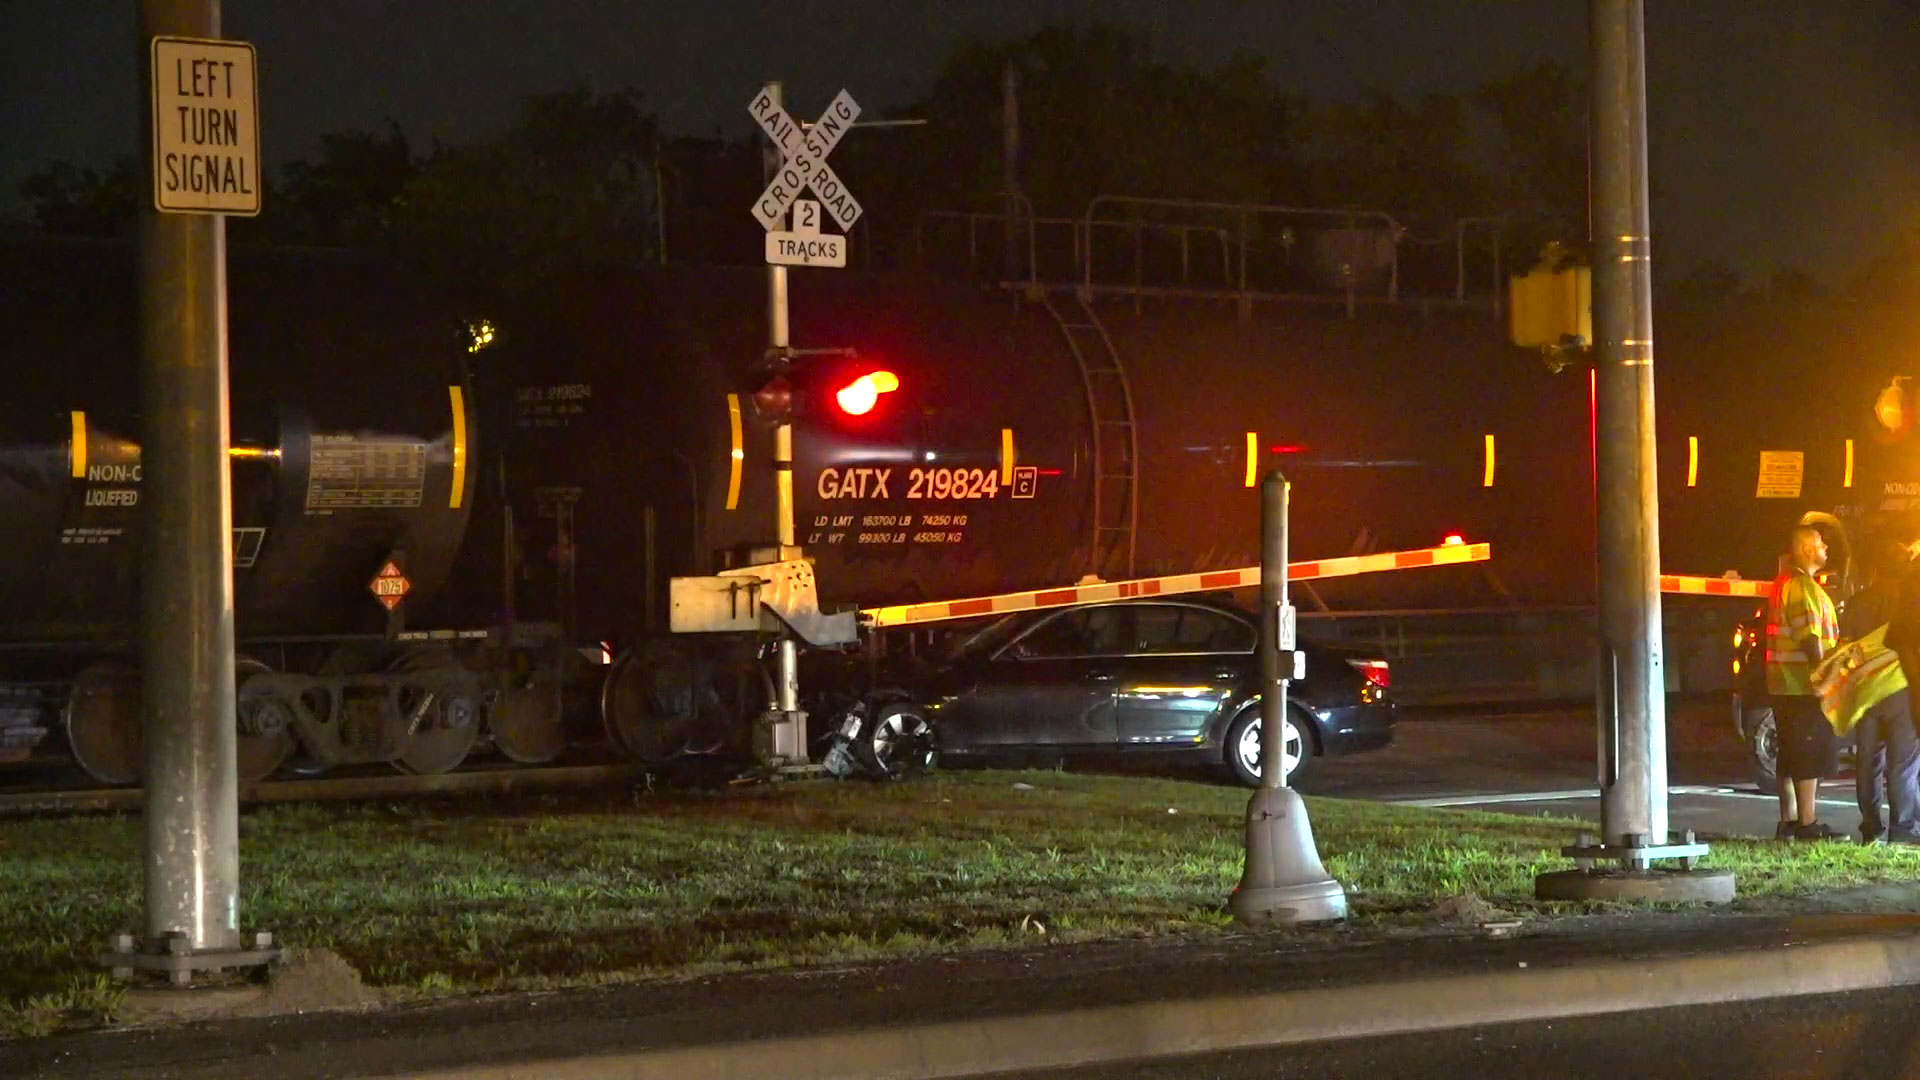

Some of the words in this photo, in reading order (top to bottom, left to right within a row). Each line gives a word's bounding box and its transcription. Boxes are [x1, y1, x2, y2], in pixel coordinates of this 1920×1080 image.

[177, 58, 235, 99] LEFT
[177, 106, 238, 147] TURN
[754, 95, 793, 150] RAIL
[812, 168, 857, 224] ROAD
[762, 101, 851, 219] CROSSING
[165, 152, 252, 195] SIGNAL
[801, 207, 815, 228] 2
[778, 239, 838, 259] TRACKS
[817, 467, 892, 501] GATX
[906, 467, 999, 500] 219824
[1020, 481, 1029, 493] C
[85, 489, 138, 507] LIQUEFIED
[814, 515, 829, 527] LD
[832, 515, 855, 527] LMT
[898, 515, 913, 526] LB
[921, 515, 951, 526] 74250
[952, 515, 968, 526] KG
[807, 533, 823, 544] LT
[828, 533, 846, 544] WT
[892, 532, 907, 544] LB
[946, 532, 963, 543] KG
